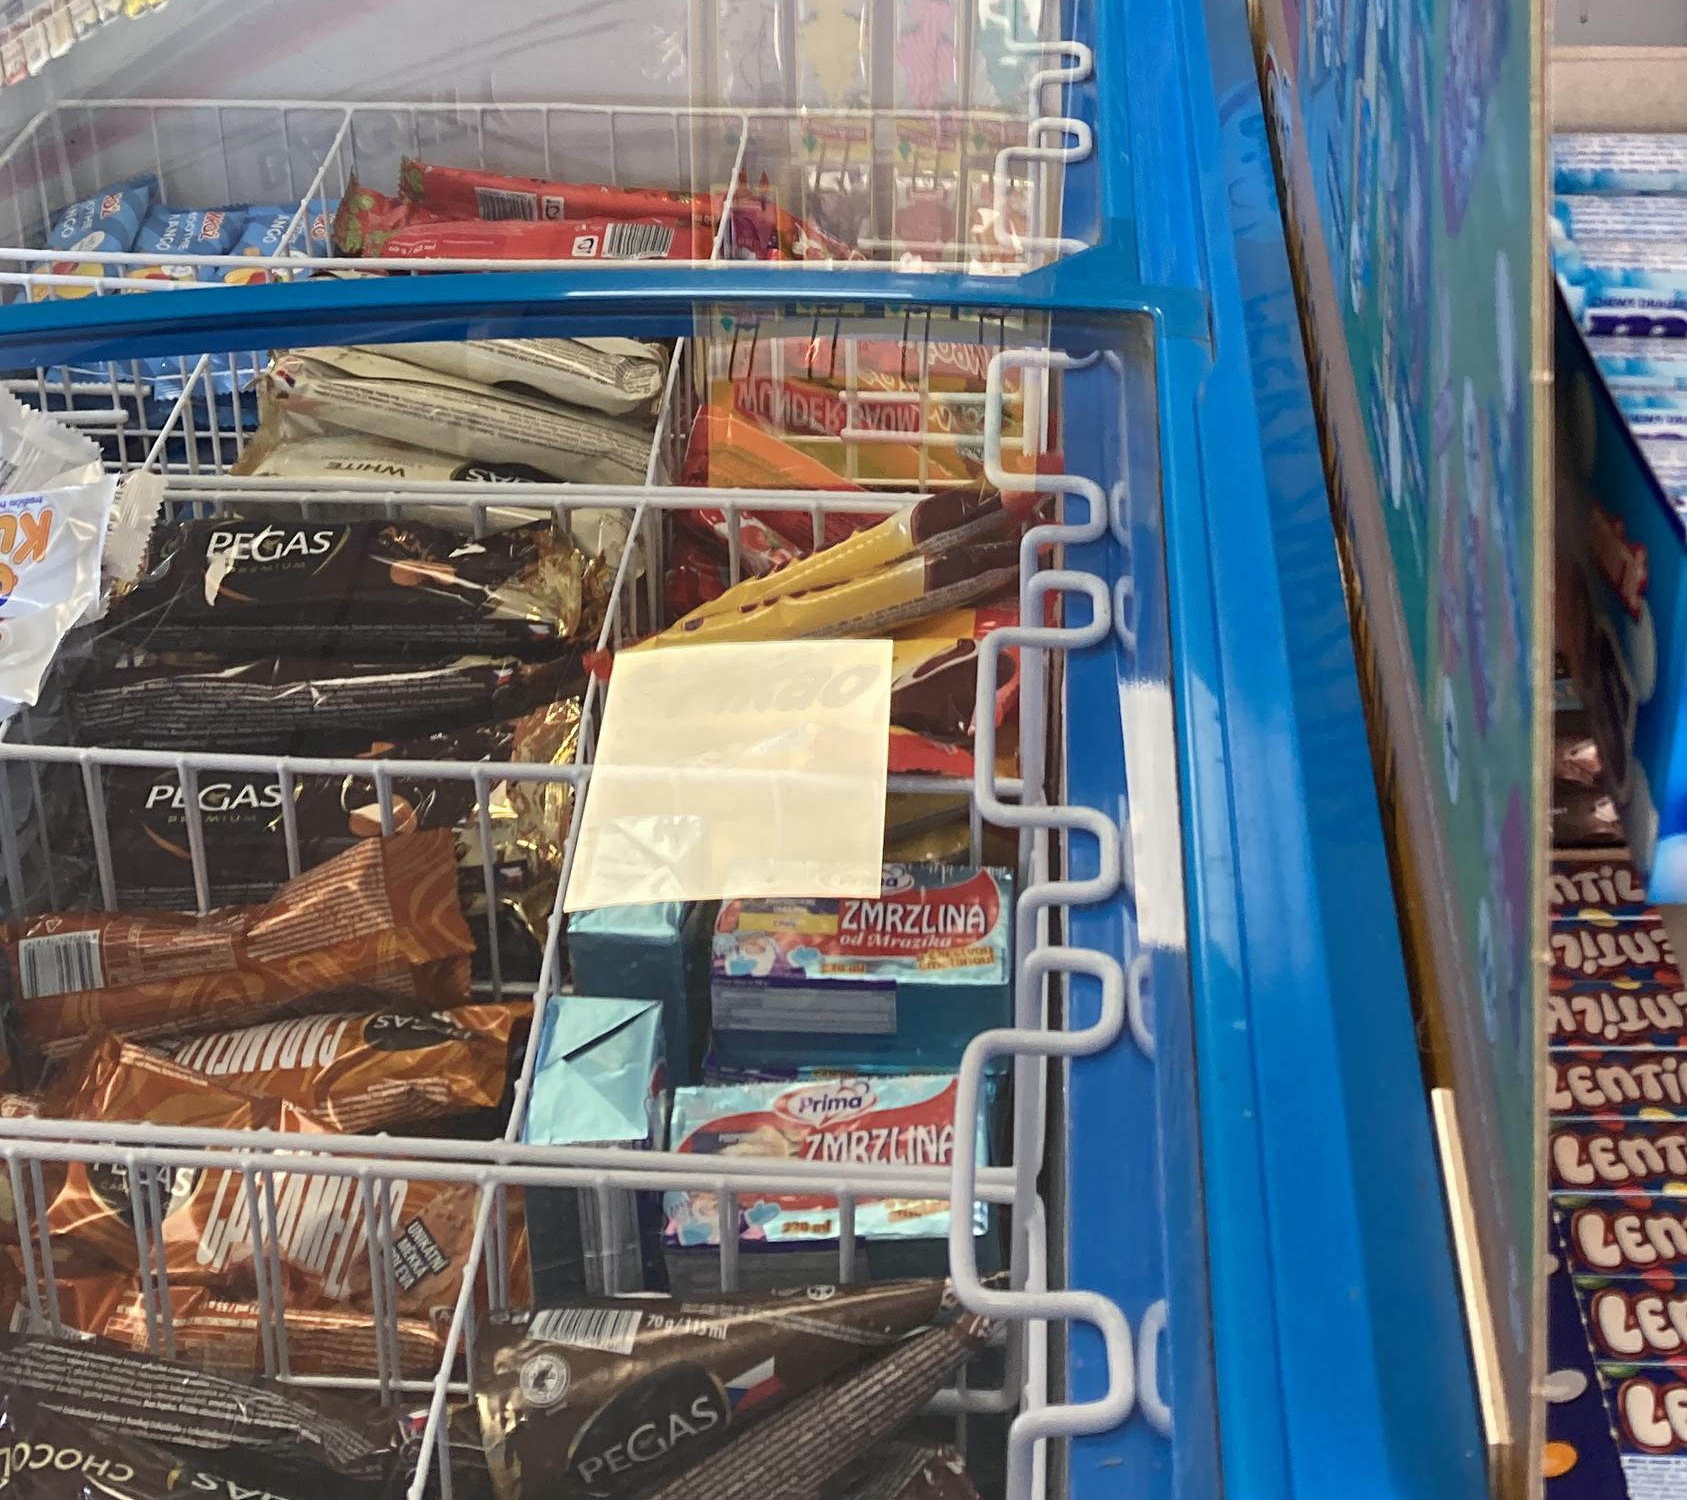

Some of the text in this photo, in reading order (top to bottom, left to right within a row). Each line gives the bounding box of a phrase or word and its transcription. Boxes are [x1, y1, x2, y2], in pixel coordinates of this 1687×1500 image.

[323, 461, 406, 478] WHITE
[206, 524, 334, 562] PEGAS
[840, 900, 986, 935] ZMRZLINA
[799, 1093, 864, 1113] Prima
[576, 1395, 720, 1485] PEGAS
